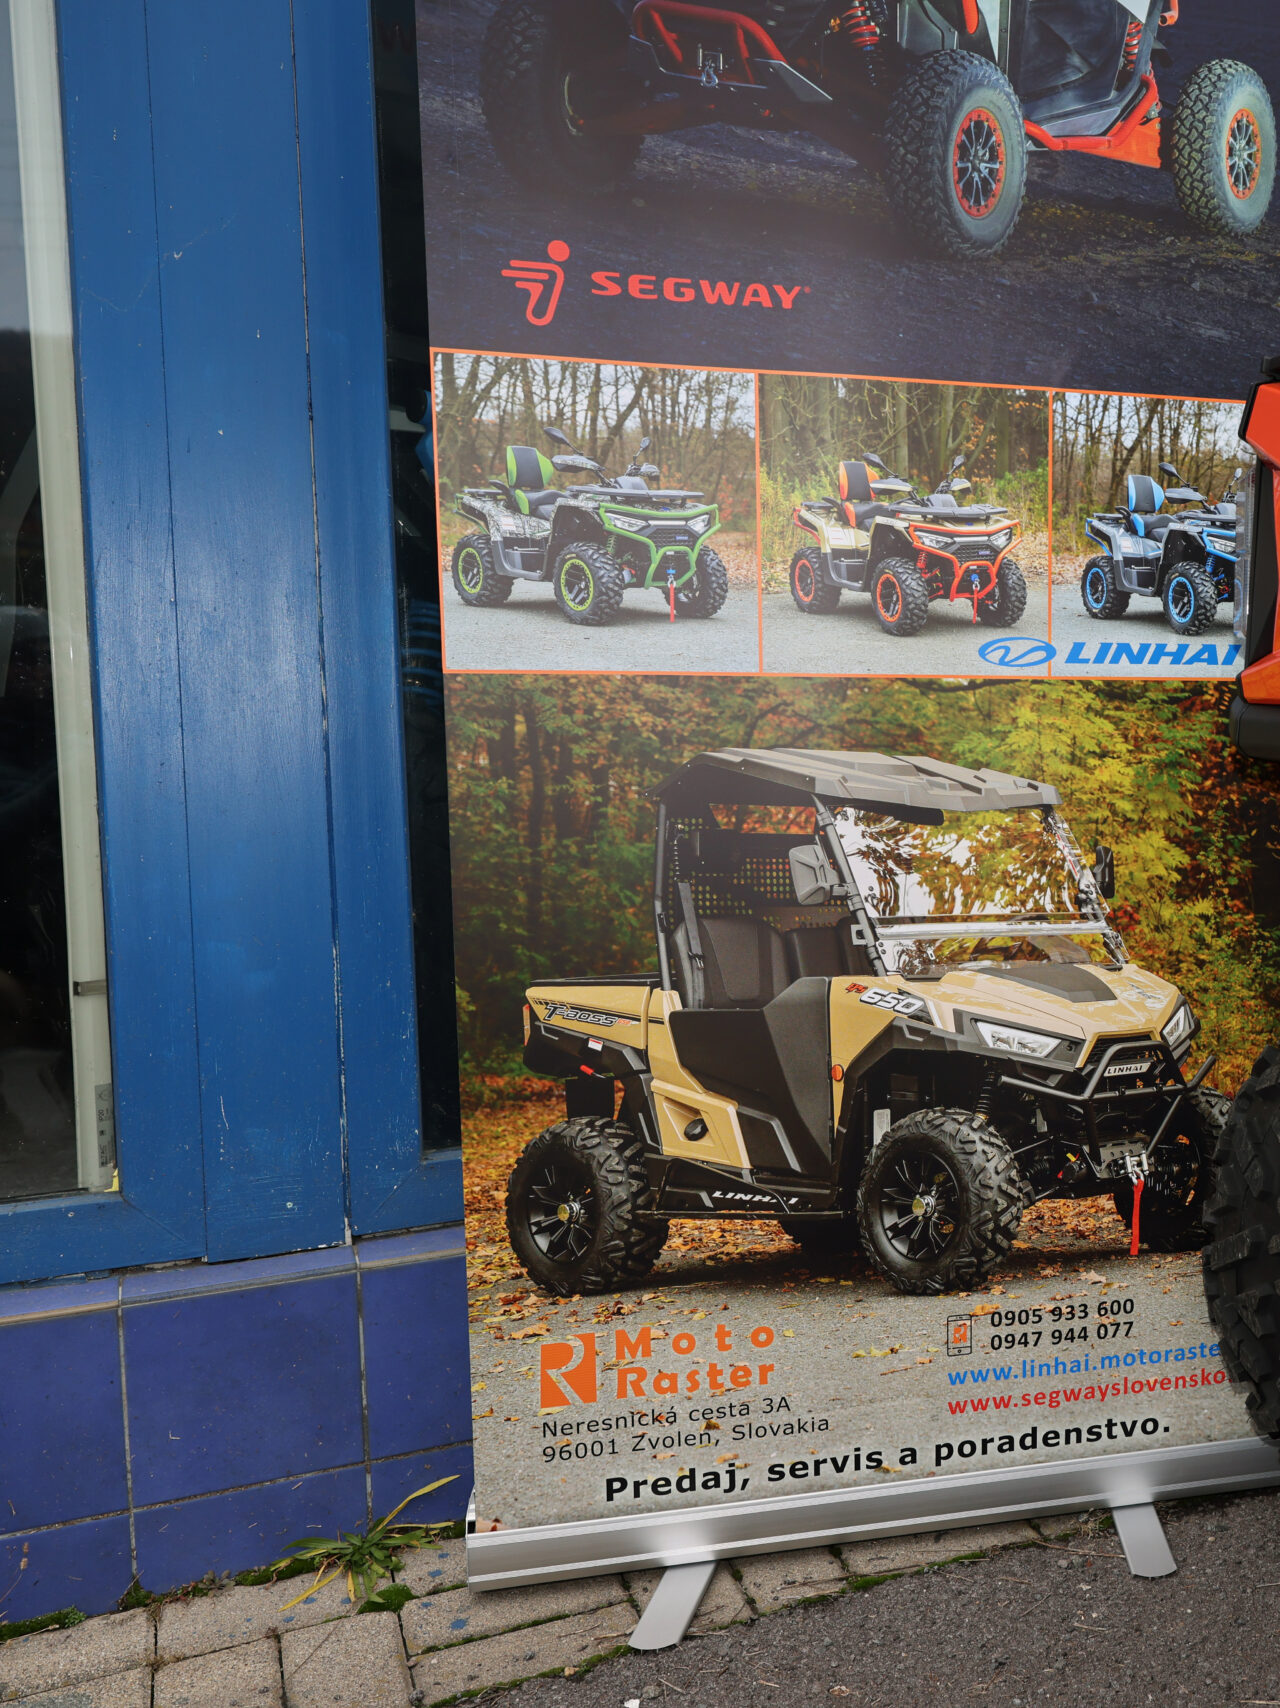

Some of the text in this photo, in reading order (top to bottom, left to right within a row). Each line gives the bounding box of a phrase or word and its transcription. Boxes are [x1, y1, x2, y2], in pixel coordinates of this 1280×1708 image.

[591, 271, 801, 309] SEGWAY
[1064, 642, 1242, 665] LINHAI
[860, 987, 924, 1015] 650
[1107, 1064, 1143, 1075] LINHAI
[990, 1298, 1135, 1327] 0905 933 600
[615, 1324, 775, 1360] Moto
[990, 1321, 1134, 1350] 0947 944 077
[616, 1362, 775, 1399] Raster
[947, 1342, 1221, 1385] www.linhai.motoraste
[947, 1367, 1232, 1415] www.segwayslovensko.
[542, 1396, 791, 1438] Neresnická cesta 3A
[542, 1417, 830, 1463] 96001 Zvolen, Slovakia
[606, 1417, 1170, 1502] Predaj, servis a poradenstvo.
